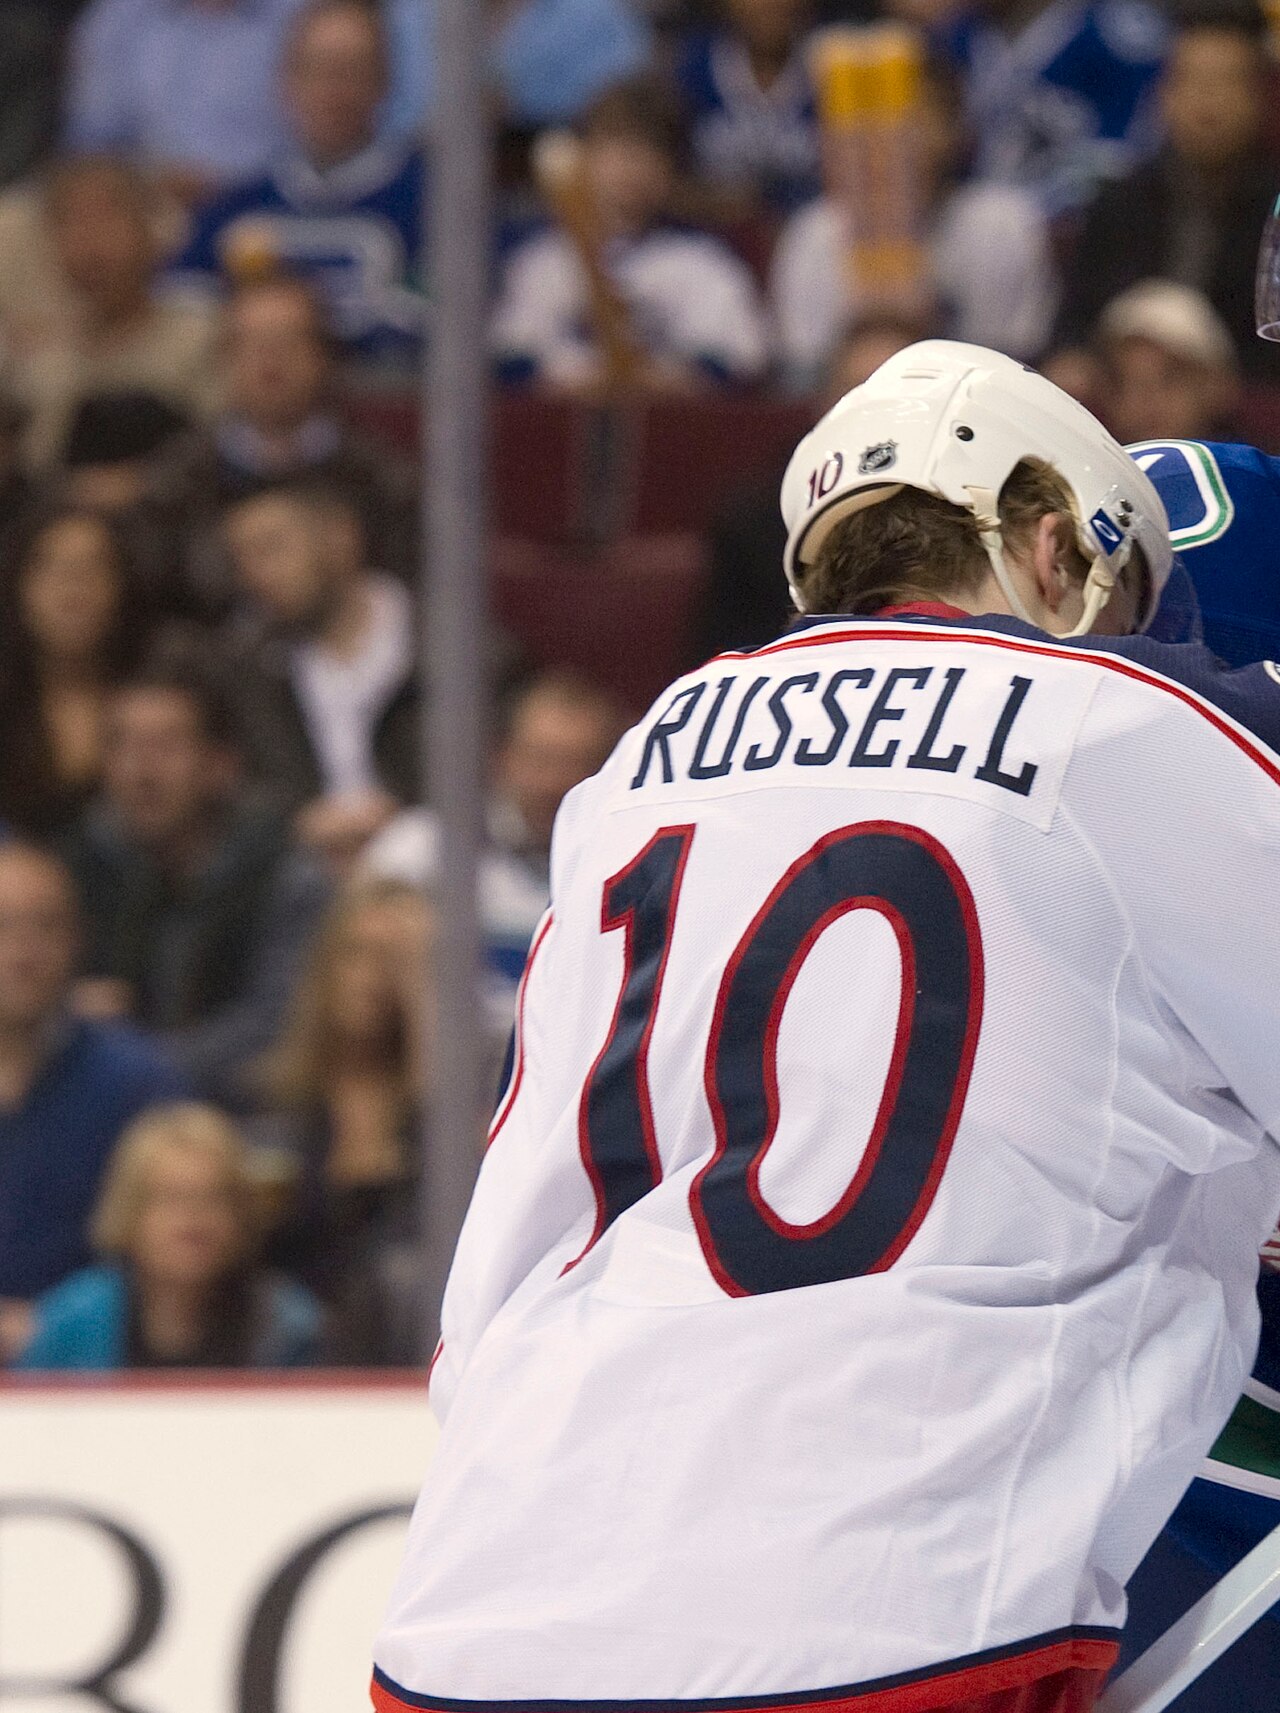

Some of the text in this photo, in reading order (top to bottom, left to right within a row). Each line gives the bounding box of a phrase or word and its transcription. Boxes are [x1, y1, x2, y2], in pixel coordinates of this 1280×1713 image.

[807, 452, 843, 510] 10
[630, 667, 1038, 797] RUSSELL
[558, 820, 985, 1299] 10
